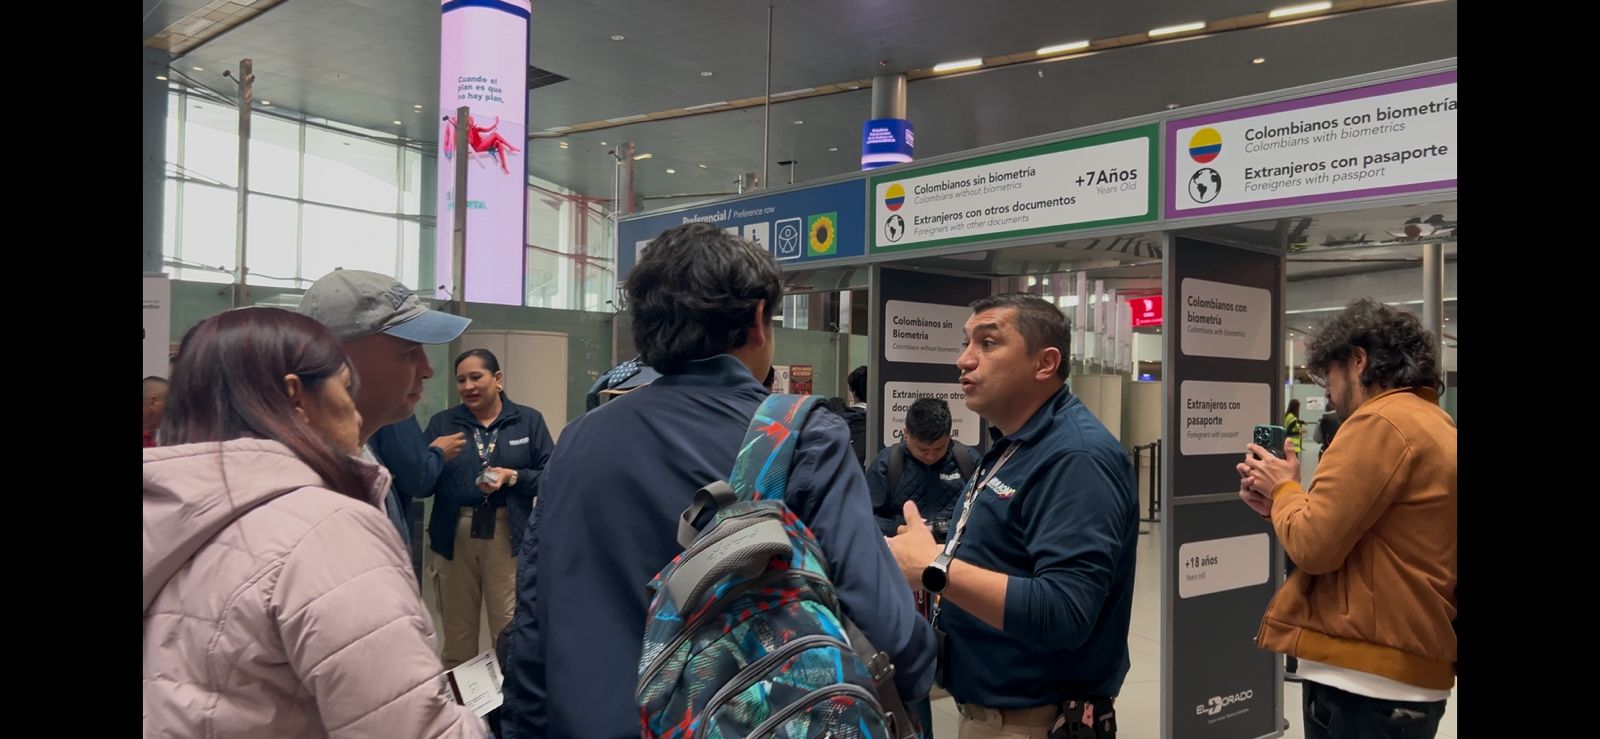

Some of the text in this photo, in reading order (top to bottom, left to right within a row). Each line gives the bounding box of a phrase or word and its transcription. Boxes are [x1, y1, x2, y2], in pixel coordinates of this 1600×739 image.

[457, 84, 473, 93] plan
[468, 92, 483, 101] hay
[1245, 97, 1457, 141] Colombianos con biometría
[1245, 121, 1406, 153] Colombians with biometrics
[1245, 143, 1448, 179] Extranjeros con pasaporte
[914, 166, 1036, 195] Colombianos sin biometría
[1244, 166, 1385, 192] Foreigners with passport
[914, 181, 1022, 205] Colombians without biometrics
[1096, 181, 1137, 195] Years Old
[733, 208, 763, 219] Preference
[914, 195, 1076, 225] Extranjeros con otros documentos
[914, 215, 1030, 236] Foreigners with other documents
[1187, 295, 1248, 313] Colombianos con
[892, 316, 953, 329] Colombianos sin
[1187, 311, 1222, 326] biometría
[892, 329, 929, 340] Biometría
[892, 389, 933, 400] Extranjeros
[1187, 398, 1241, 413] Extranjeros con
[1186, 415, 1223, 428] pasaporte
[1185, 554, 1218, 568] +18 años
